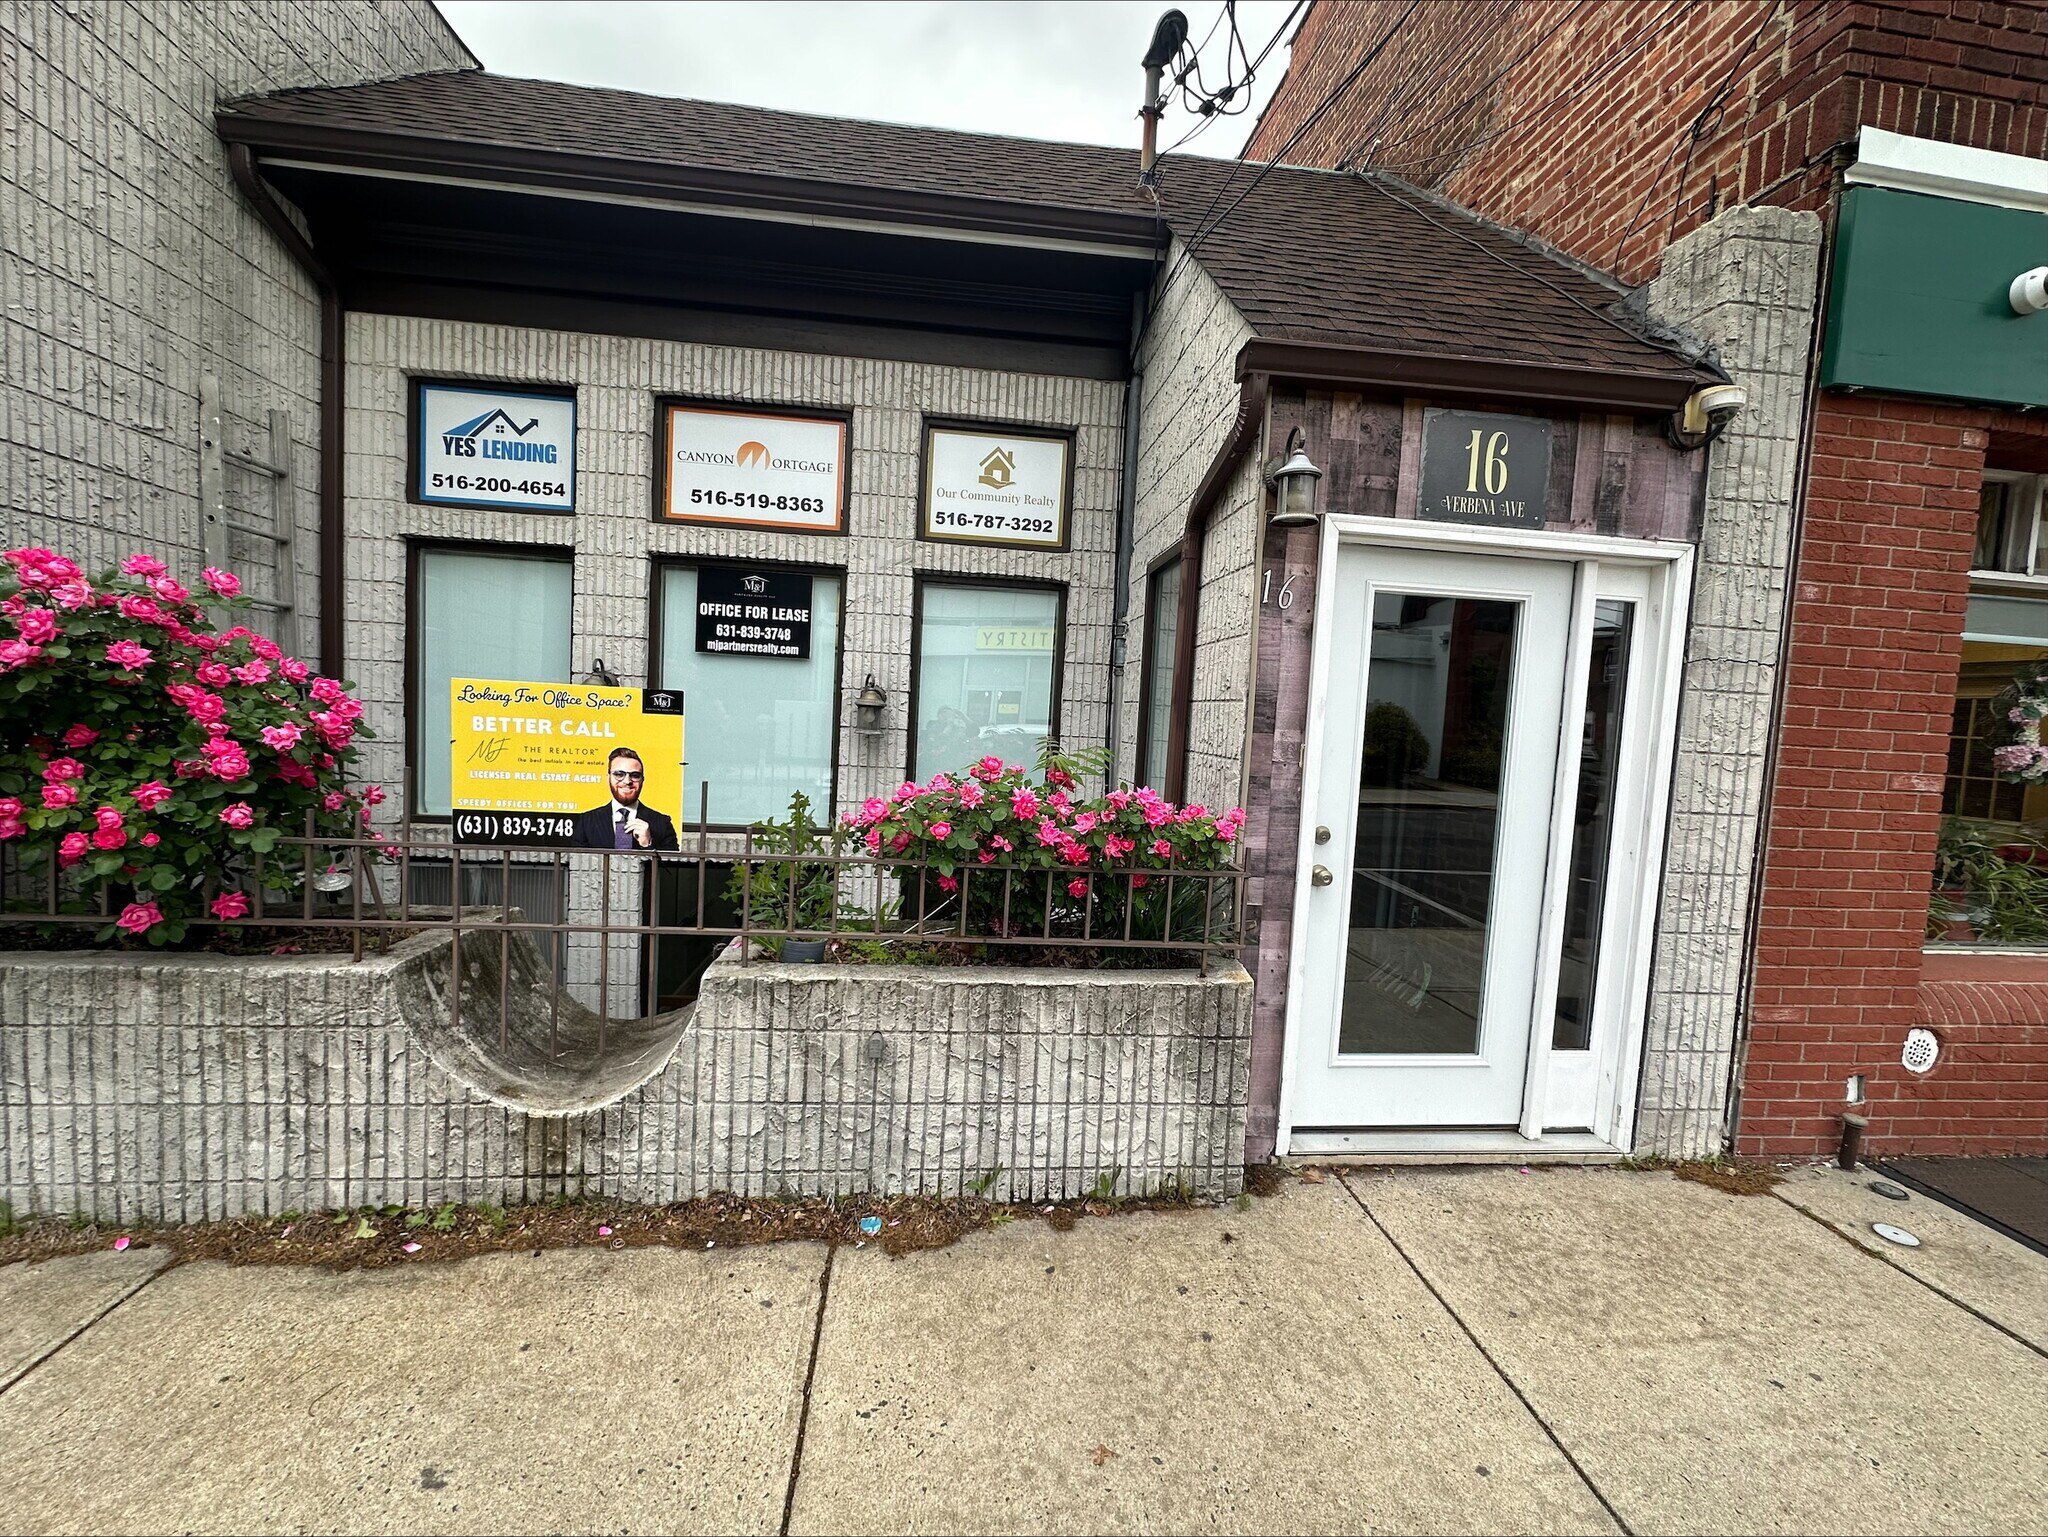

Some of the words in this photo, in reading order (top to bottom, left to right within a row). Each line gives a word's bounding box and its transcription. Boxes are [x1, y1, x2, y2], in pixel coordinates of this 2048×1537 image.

[442, 436, 476, 457] YES
[482, 439, 557, 464] LENDING
[677, 450, 734, 465] CANYON
[1465, 428, 1510, 495] 16
[432, 473, 565, 497] 516-200-4654
[690, 489, 824, 513] 516-519-8363
[936, 487, 957, 499] Our
[960, 489, 1021, 506] Community
[1024, 494, 1056, 509] Realty
[1440, 495, 1496, 517] VERBENA
[1499, 500, 1525, 519] AVE
[935, 511, 1053, 533] 516-787-3292
[1261, 569, 1296, 610] 16
[700, 602, 742, 618] OFFICE
[745, 605, 768, 620] FOR
[772, 607, 809, 622] LEASE
[716, 624, 791, 641] 631-839-3748
[707, 640, 800, 655] mjpartnersrealty.com
[457, 685, 512, 707] Looking
[515, 688, 540, 703] For
[543, 690, 582, 709] Office
[586, 693, 632, 710] Space?
[472, 715, 553, 735] BETTER
[560, 720, 616, 738] CALL
[469, 770, 511, 780] LICENSED
[514, 772, 537, 781] REAL
[540, 773, 571, 782] ESTATE
[573, 774, 602, 783] AGENT
[457, 798, 492, 807] SPEEDY
[496, 800, 533, 808] OFFICES
[536, 801, 554, 809] FOR
[557, 802, 578, 810] YOU!
[457, 815, 499, 840] (631)
[503, 816, 574, 837] 839-3748
